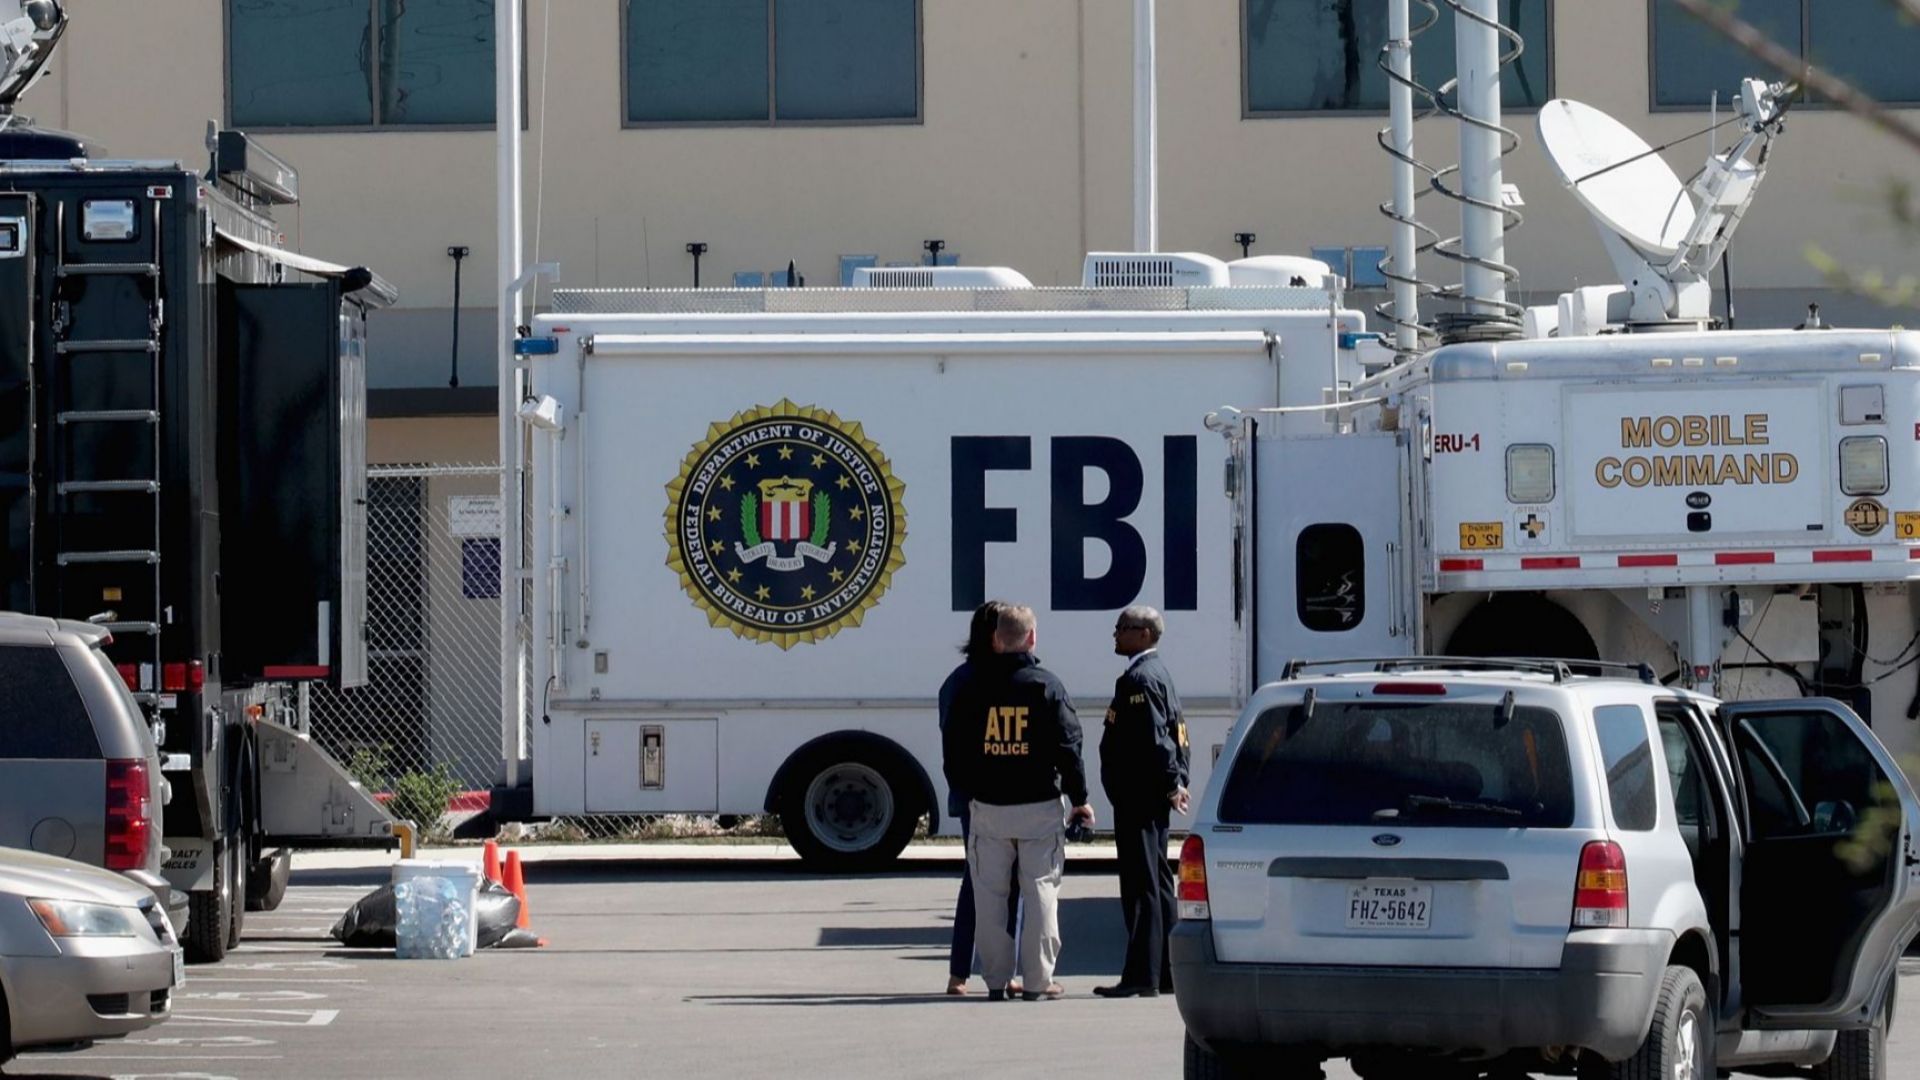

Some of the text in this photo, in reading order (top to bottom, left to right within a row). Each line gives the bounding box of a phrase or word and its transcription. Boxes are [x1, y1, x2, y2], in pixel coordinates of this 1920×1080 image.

[1435, 433, 1480, 453] ERU-1
[1621, 413, 1769, 448] MOBILE
[693, 425, 878, 495] DEPARTMENT OF JUSTICE
[1595, 452, 1799, 488] COMMAND
[951, 435, 1197, 611] FBI
[685, 503, 885, 624] FEDERAL BUREAU OF INVESTIGATION
[984, 706, 1029, 741] ATF
[984, 742, 1029, 755] POLICE
[1374, 887, 1406, 897] TEXAS
